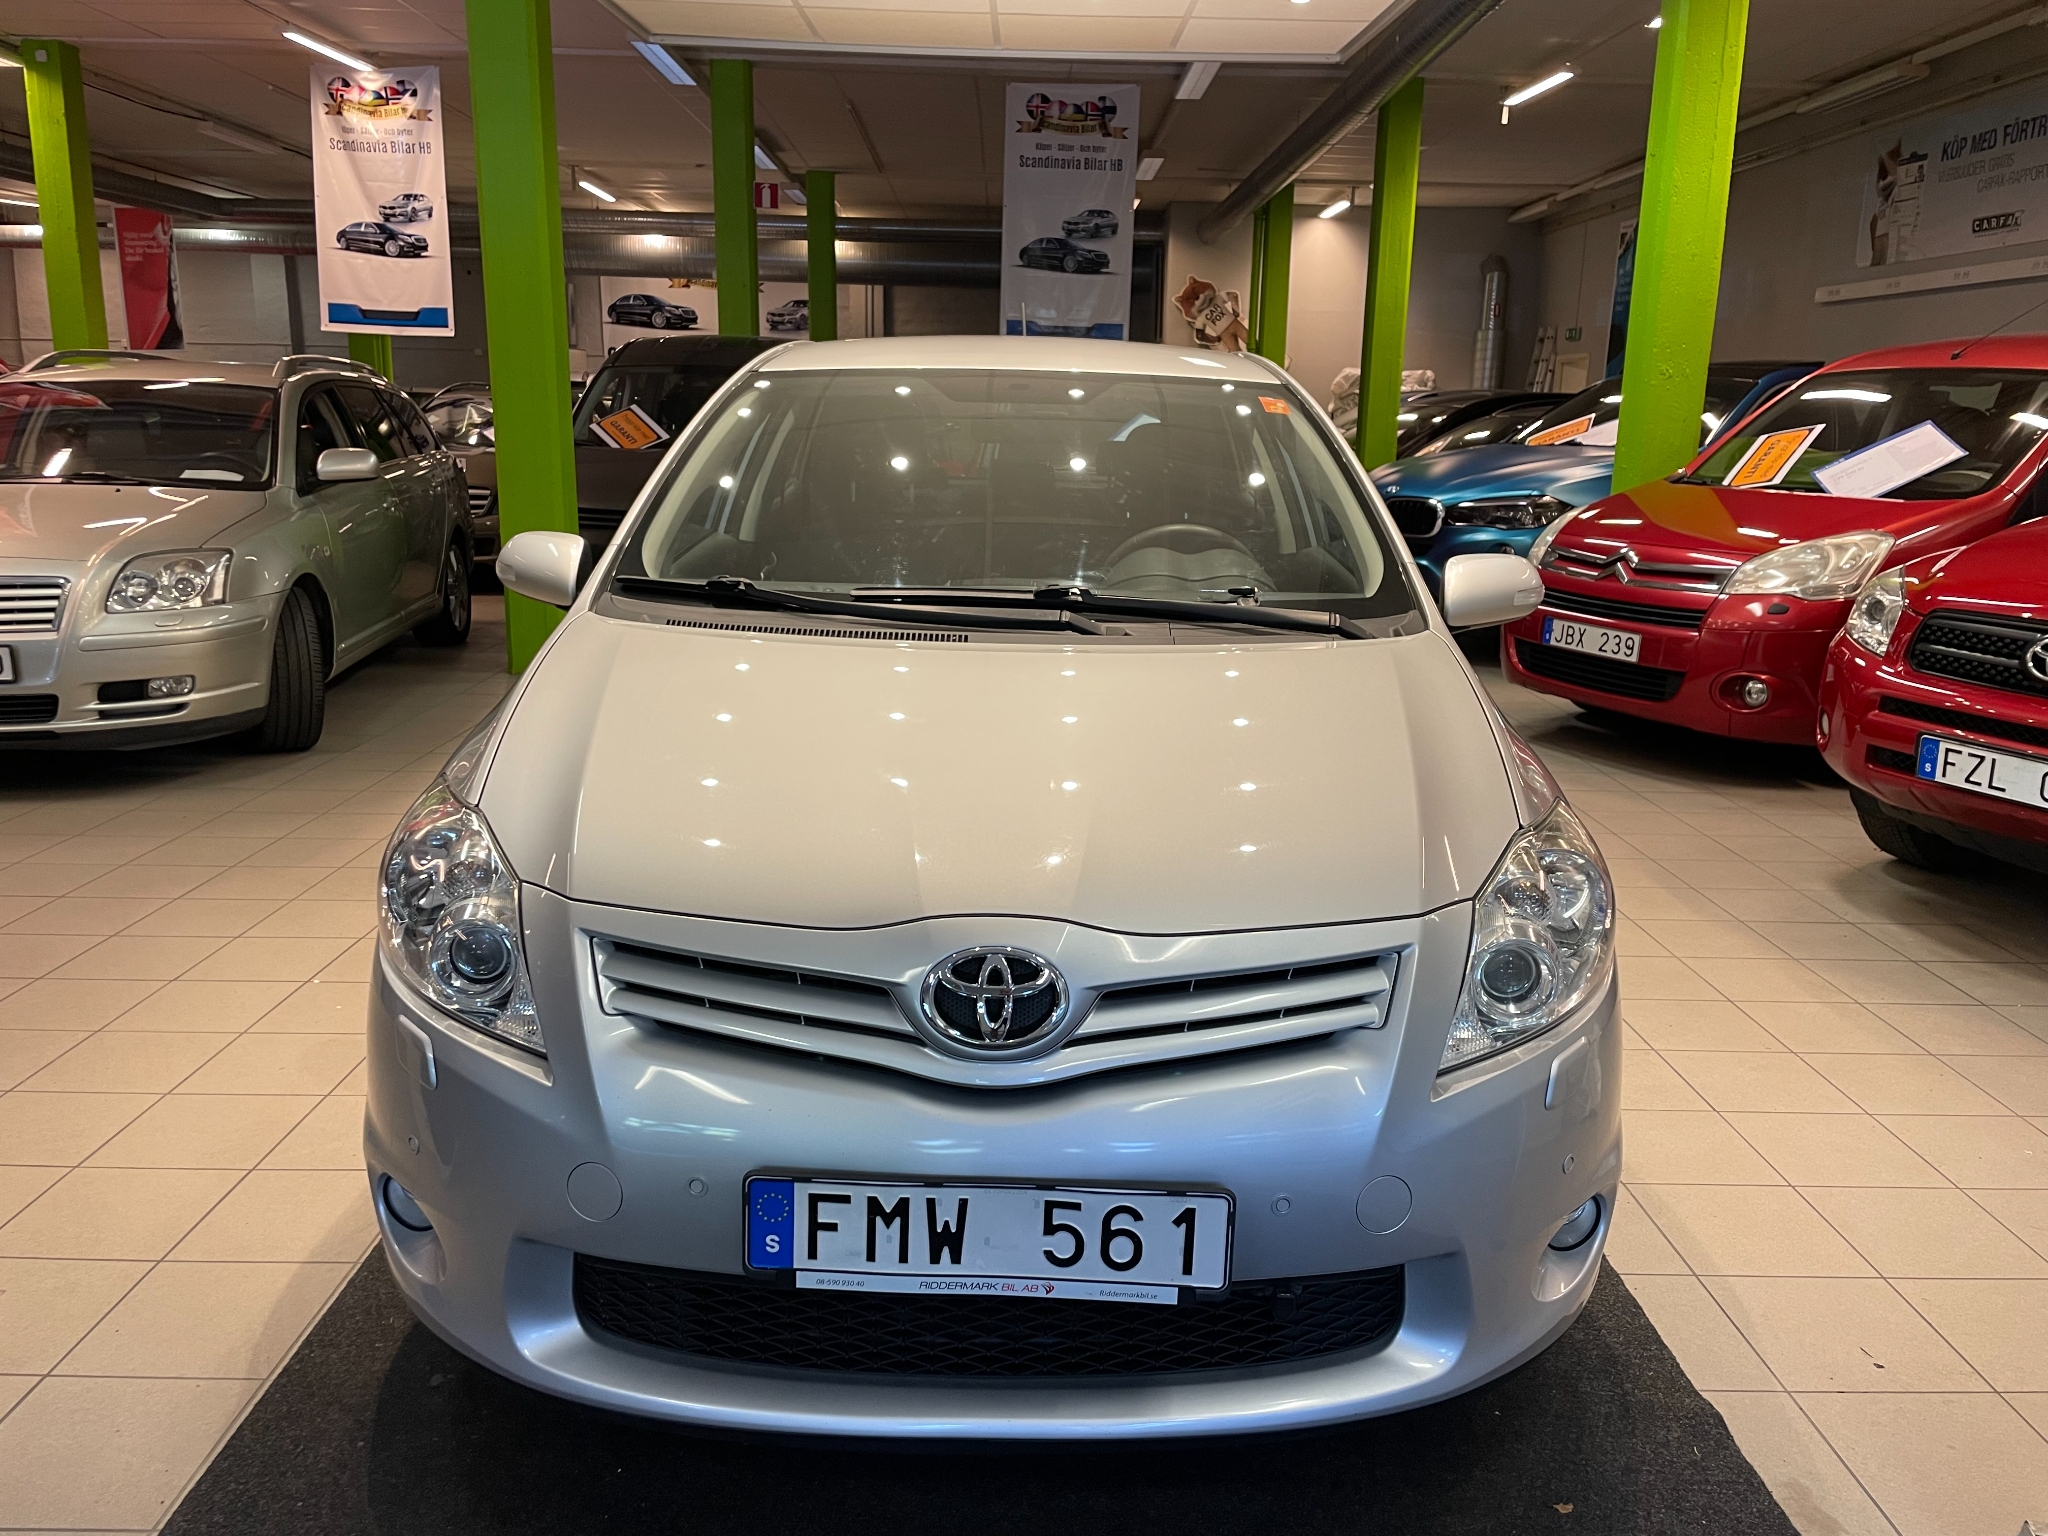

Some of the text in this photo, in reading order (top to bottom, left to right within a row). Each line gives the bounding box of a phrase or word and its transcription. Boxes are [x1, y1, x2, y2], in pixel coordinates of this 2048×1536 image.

[329, 137, 432, 155] Scandinavia Bilar HB
[1940, 114, 2048, 162] KÖP MED FÖRTR
[1019, 154, 1123, 172] Scandinavia Bilar HB
[1973, 210, 2022, 233] CARFAX
[1205, 303, 1221, 321] CAR
[1210, 310, 1227, 327] FOX
[610, 420, 638, 445] GARANTI
[1536, 428, 1580, 444] ARANTI
[1554, 623, 1635, 657] JBX 239
[1924, 762, 1932, 772] S
[1941, 747, 2007, 793] FZL
[807, 1192, 1197, 1276] FMW 561
[765, 1234, 780, 1253] S
[919, 1281, 1039, 1293] RIDDERMARK BIL AB
[1099, 1289, 1158, 1300] Riddermarkbil.se
